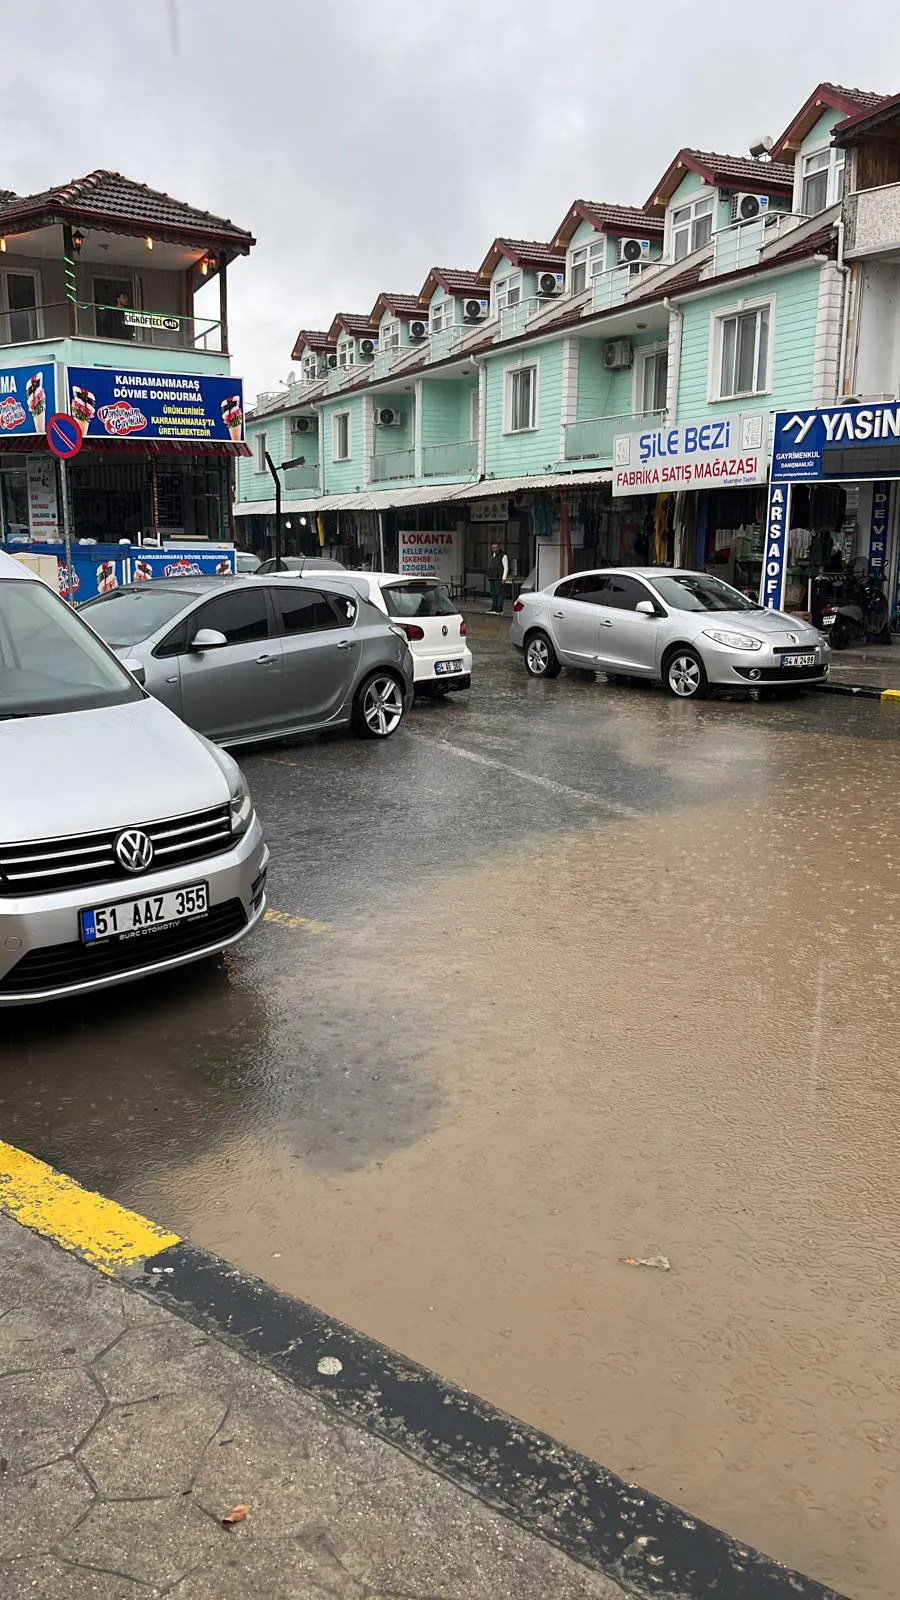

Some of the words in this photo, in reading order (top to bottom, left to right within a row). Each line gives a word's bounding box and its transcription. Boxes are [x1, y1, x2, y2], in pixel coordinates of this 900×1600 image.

[115, 375, 200, 391] KAHRAMANMARAŞ
[113, 386, 148, 399] DÖVME
[150, 390, 203, 402] DONDURMA
[163, 404, 205, 416] ÜRÜNLERİMİZ
[151, 416, 216, 429] KAHRAMANMARAŞ'TA
[158, 425, 211, 437] ÜRETİLMEKTEDİR
[776, 451, 821, 460] GAYRİMENKUL
[616, 467, 659, 487] FABRİKA
[662, 464, 692, 484] SATIŞ
[694, 457, 758, 481] MAĞAZASI
[402, 533, 454, 545] LOKANTA
[402, 547, 423, 555] KELLE
[424, 547, 443, 556] PAÇA
[402, 556, 432, 564] İŞKEMBE
[85, 927, 96, 936] TR
[95, 908, 118, 935] 51
[132, 897, 165, 927] AAZ
[175, 887, 206, 916] 355
